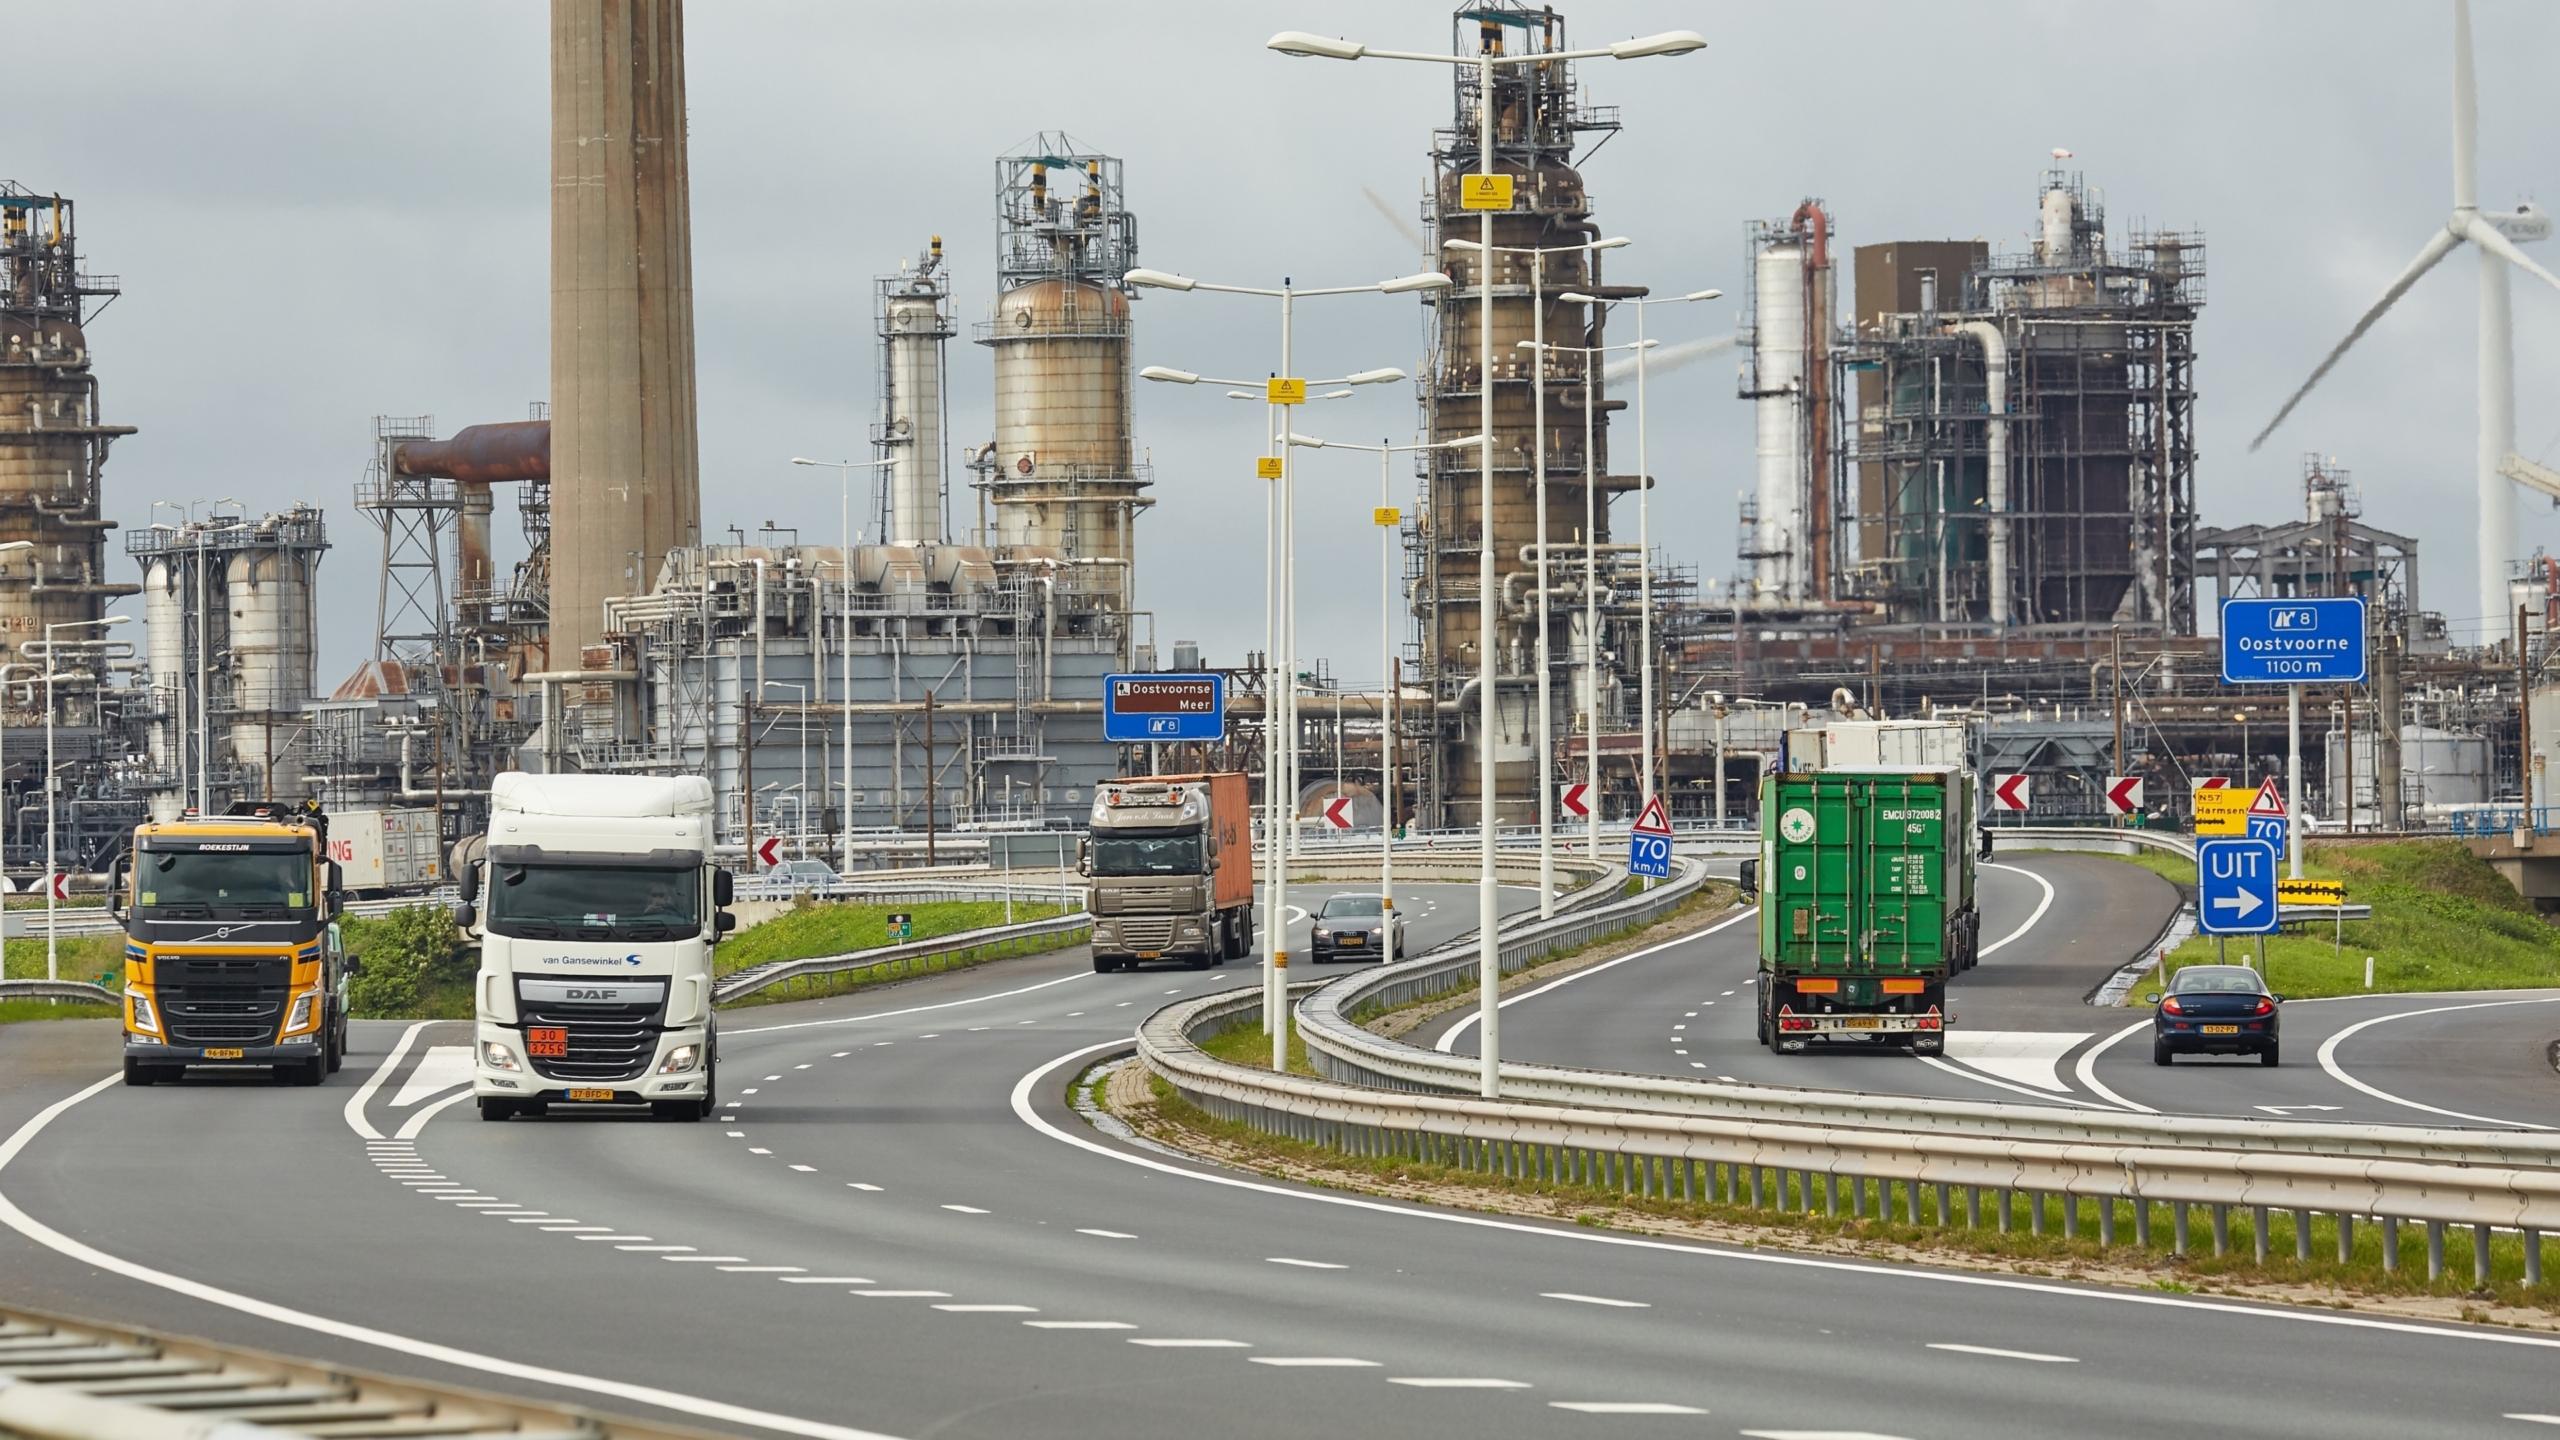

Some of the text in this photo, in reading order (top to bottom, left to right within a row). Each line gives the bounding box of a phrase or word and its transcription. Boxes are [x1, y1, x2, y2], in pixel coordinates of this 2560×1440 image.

[2300, 612, 2310, 625] 8
[2239, 636, 2349, 651] Oostvoorne
[2266, 660, 2321, 673] 1100 m
[1132, 683, 1211, 694] Oostvoornse
[1179, 699, 1211, 710] Meer
[1168, 721, 1176, 731] 8
[1113, 811, 1133, 823] Jan
[1883, 810, 1905, 820] EMCU
[1782, 826, 1812, 841] EVERGREEN
[1635, 837, 1667, 860] 70
[1633, 861, 1665, 874] km/h
[2212, 852, 2263, 879] UIT
[543, 956, 622, 966] van Gansewinkel
[566, 989, 617, 1000] DAF
[540, 1030, 556, 1041] 30
[531, 1044, 564, 1055] 3256
[573, 1090, 610, 1098] 37-BFD-9
